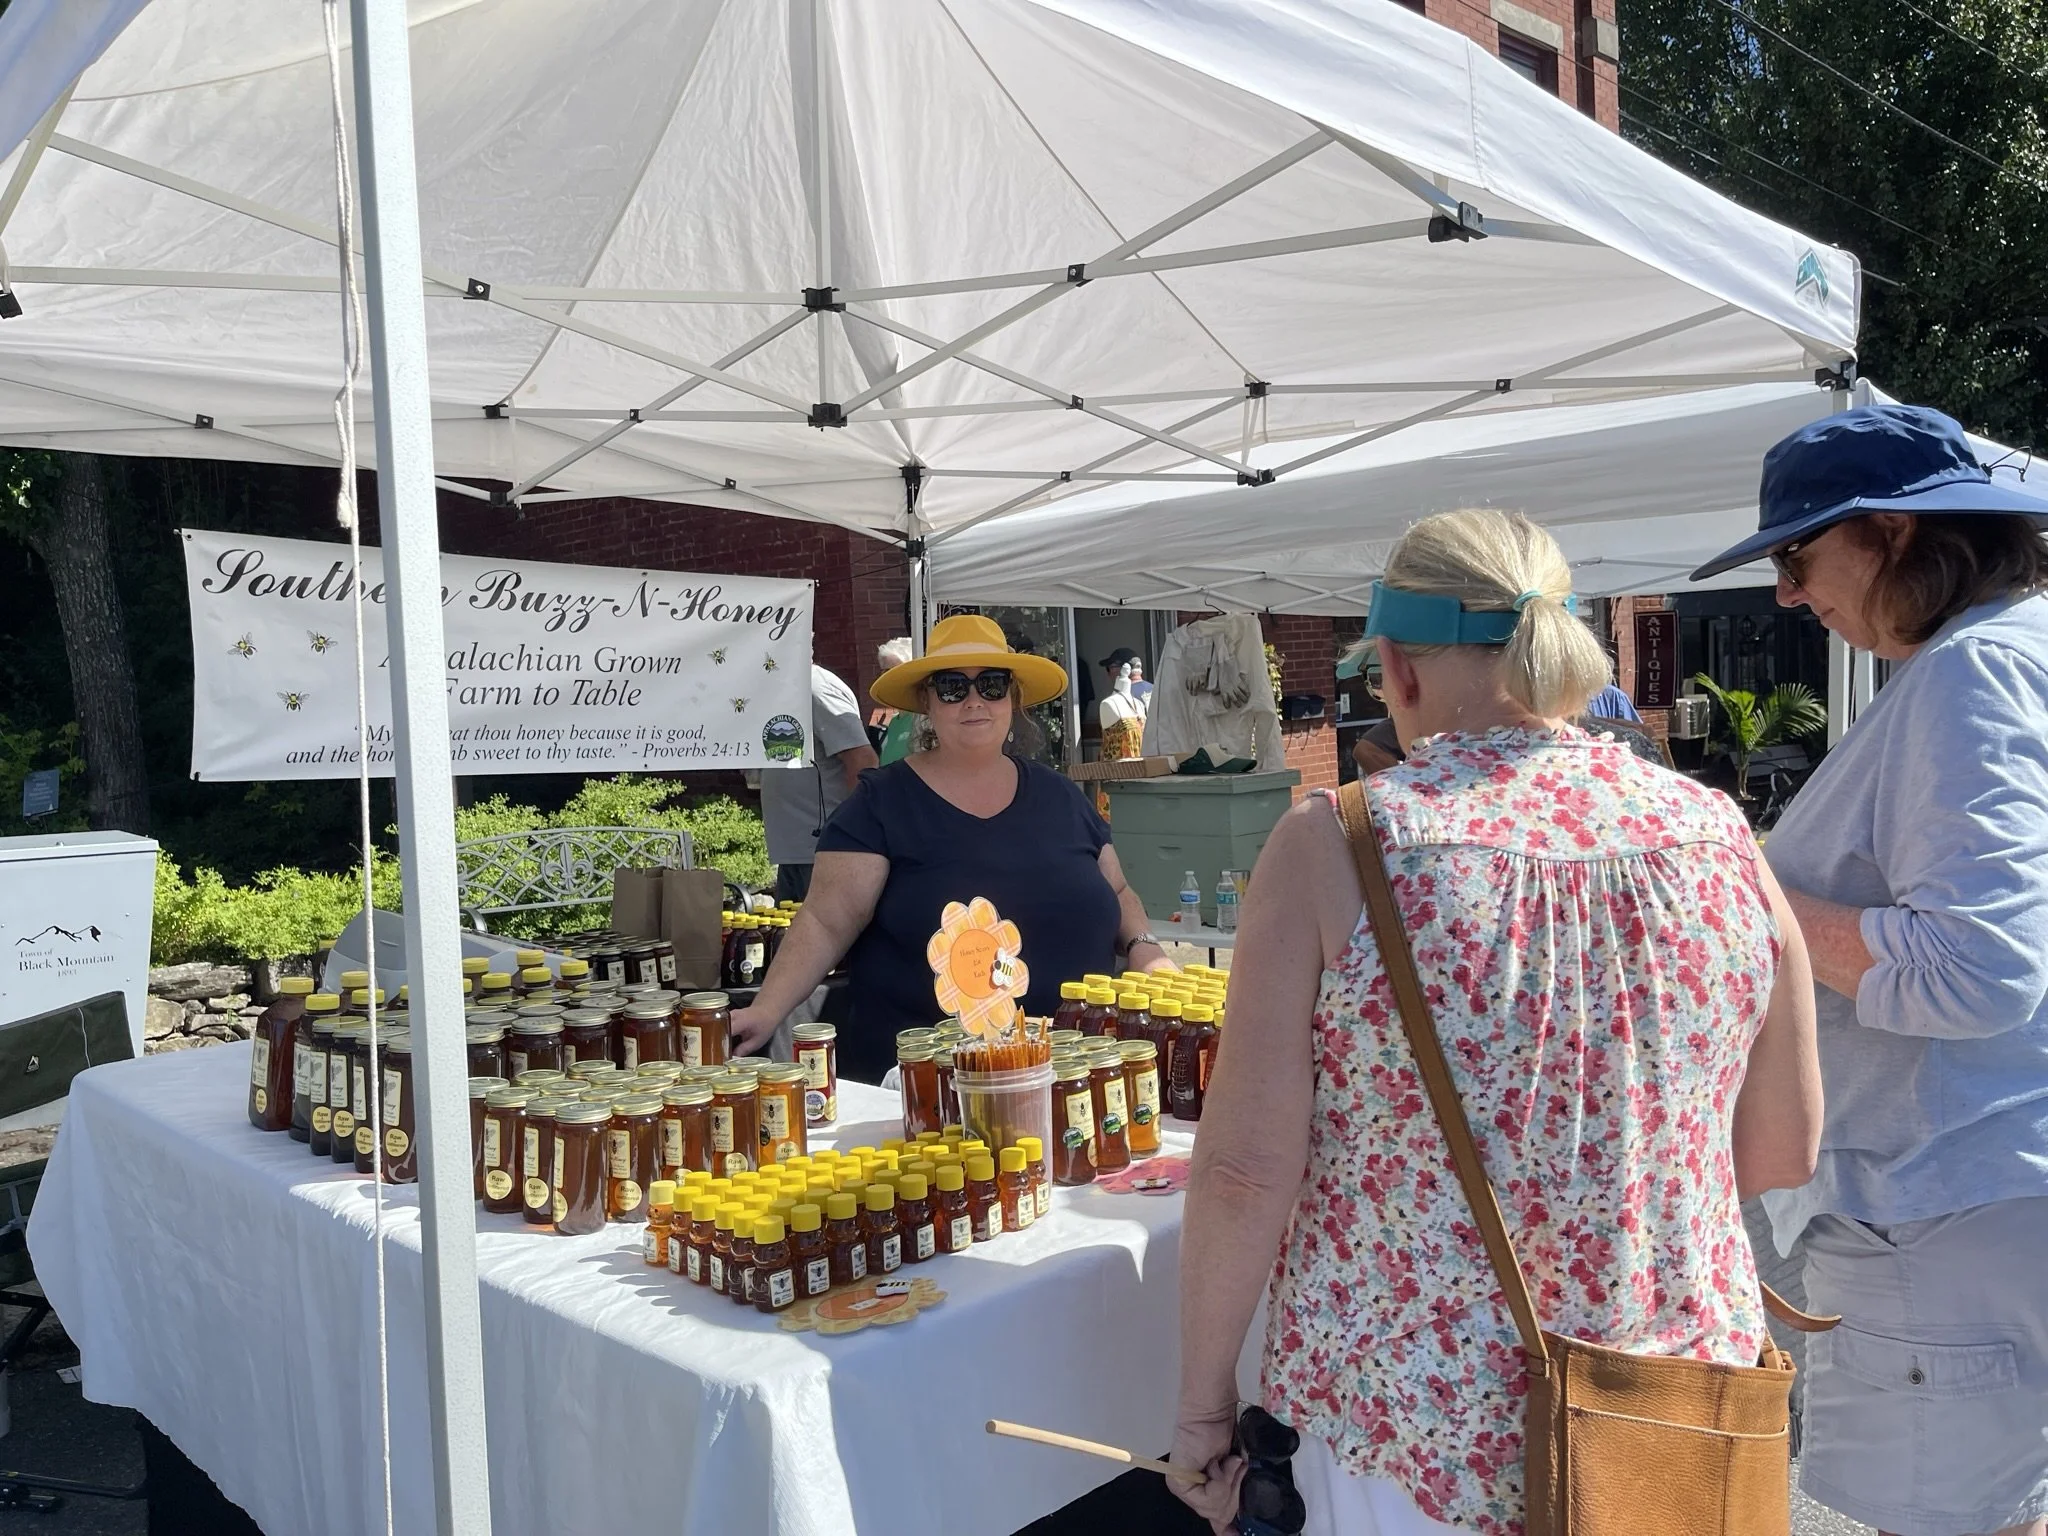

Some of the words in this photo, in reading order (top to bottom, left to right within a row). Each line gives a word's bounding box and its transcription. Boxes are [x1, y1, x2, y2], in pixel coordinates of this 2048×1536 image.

[202, 549, 462, 607] Southen
[468, 569, 804, 641] Buzz-N-Honey
[378, 641, 582, 672] alachian
[594, 646, 681, 674] Grown
[1647, 616, 1661, 704] ANTIQUES
[533, 682, 560, 706] to
[569, 679, 642, 706] Table
[474, 724, 511, 741] thou
[516, 723, 564, 743] honey
[569, 724, 632, 740] because
[636, 725, 647, 740] it
[651, 725, 663, 740] is
[666, 725, 707, 744] good,
[286, 745, 326, 764] and
[330, 745, 360, 763] the
[473, 746, 521, 761] sweet
[526, 747, 541, 760] to
[547, 742, 571, 764] thy
[643, 743, 708, 758] Proverbs
[711, 742, 751, 758] 24:13
[44, 947, 54, 956] of
[19, 958, 53, 971] Black
[57, 955, 115, 967] Mountain
[620, 1185, 635, 1193] Raw
